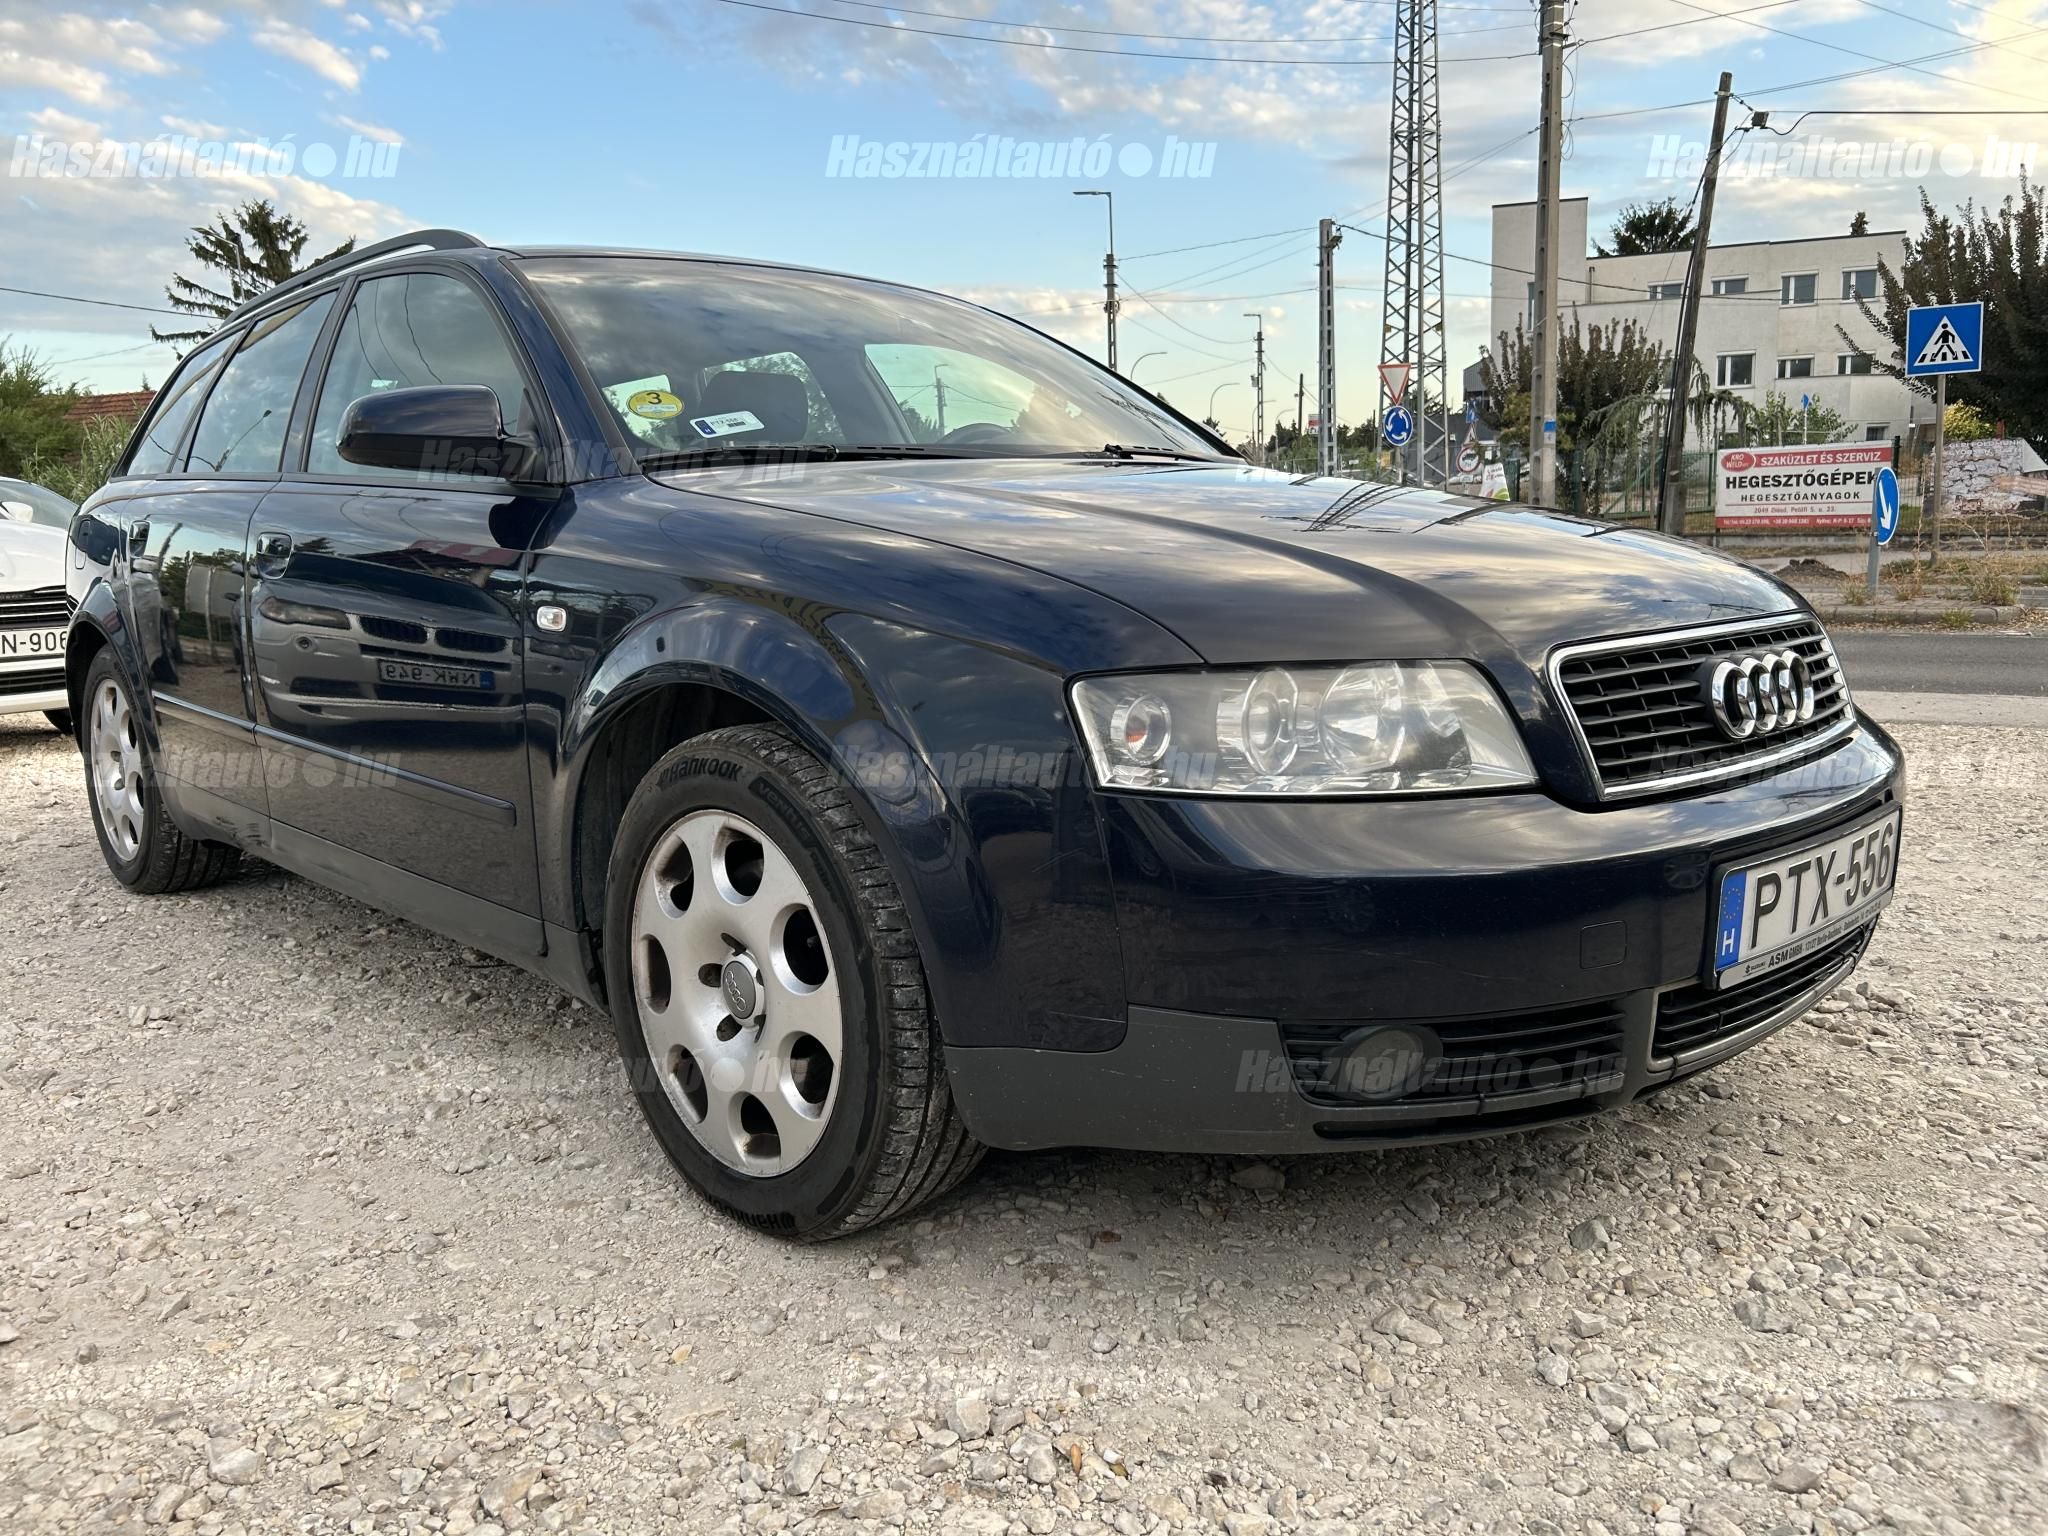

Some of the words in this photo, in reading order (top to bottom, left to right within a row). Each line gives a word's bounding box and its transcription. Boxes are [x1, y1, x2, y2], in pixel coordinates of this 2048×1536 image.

[646, 392, 662, 404] 3
[1761, 454, 1818, 466] SZAKÜZLET
[1820, 451, 1834, 464] ÉS
[1836, 451, 1882, 463] SZERVIZ
[1725, 468, 1876, 489] HEGESZTŐGÉPEK
[1741, 491, 1860, 502] HEGESZTŐANYAGOK
[1751, 821, 1894, 950] PTX-556
[1721, 928, 1735, 956] H
[1768, 949, 1789, 968] ASM
